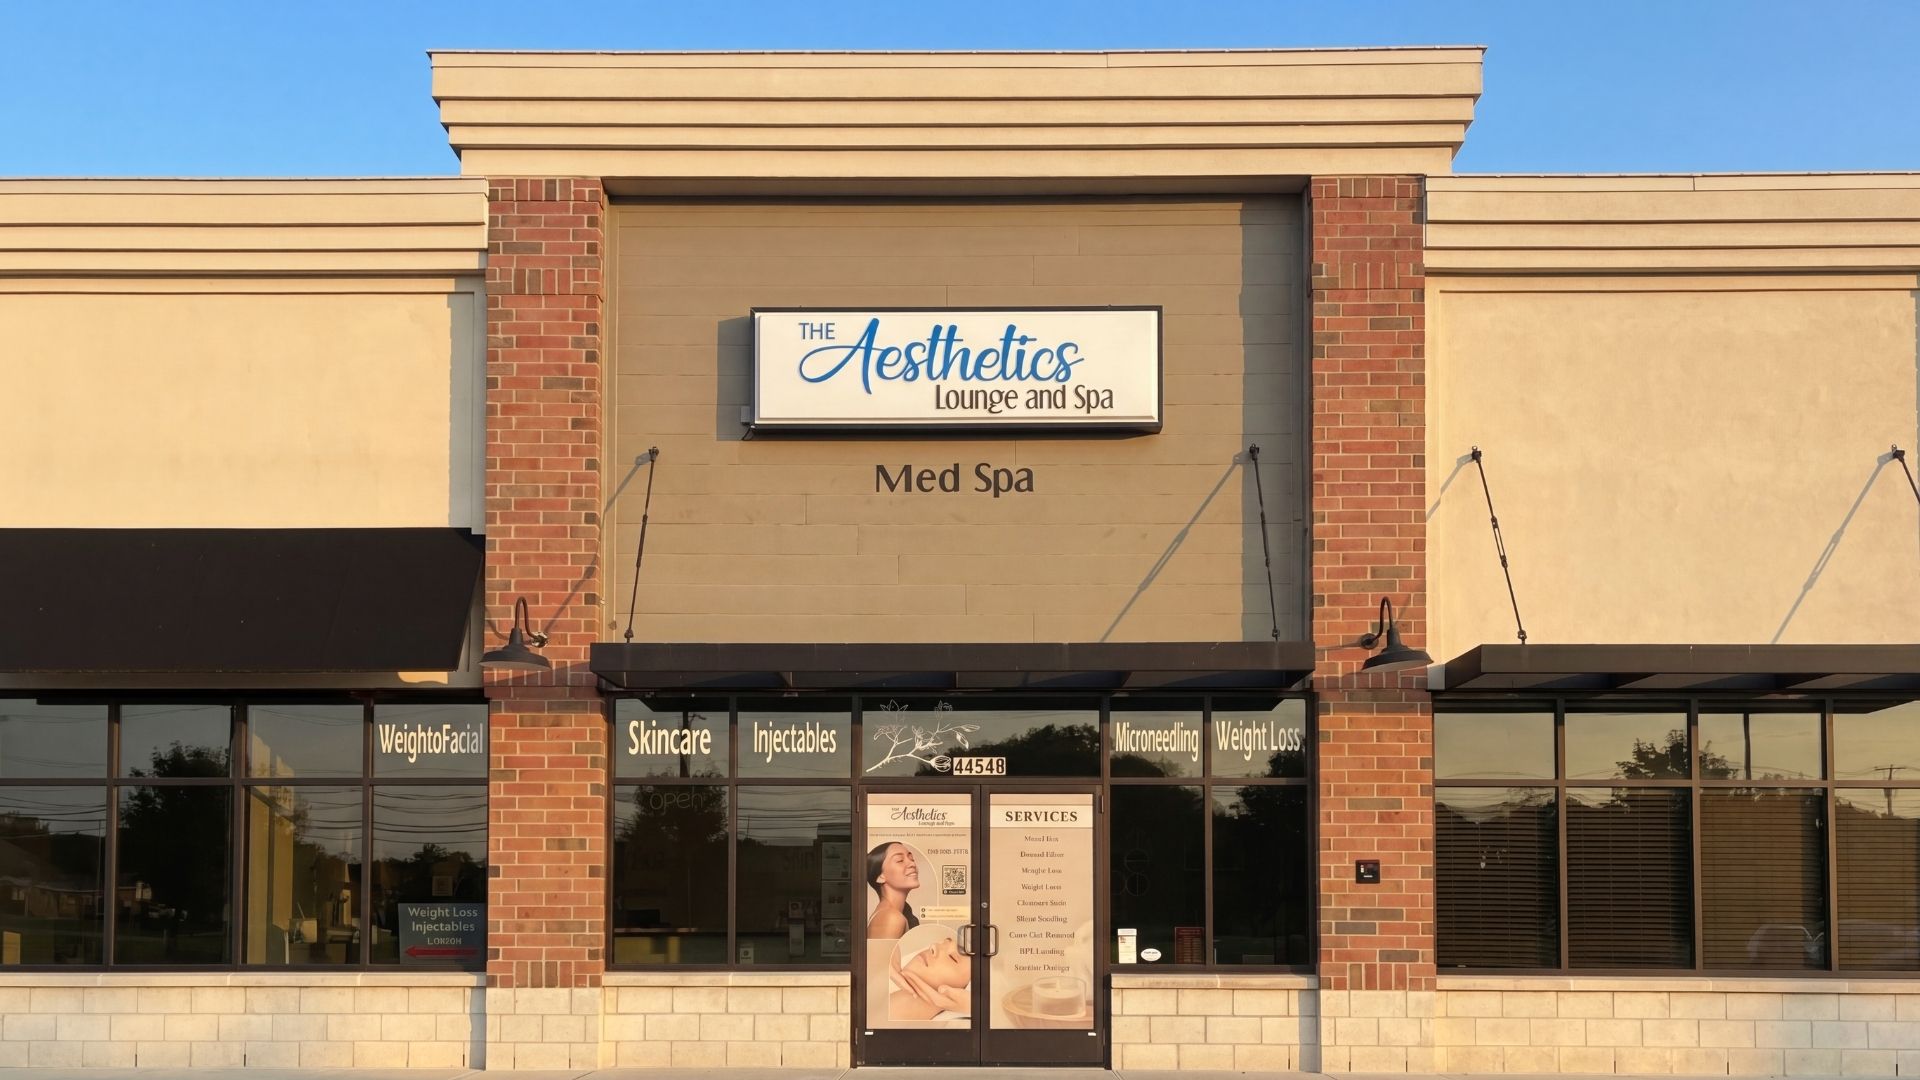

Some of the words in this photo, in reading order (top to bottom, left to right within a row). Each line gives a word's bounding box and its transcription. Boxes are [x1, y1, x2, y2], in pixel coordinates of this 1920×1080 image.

[799, 322, 836, 340] THE
[799, 317, 1085, 395] Aesthetics
[935, 385, 1018, 414] Lounge
[1025, 385, 1067, 410] and
[1073, 384, 1114, 414] Spa
[875, 463, 960, 493] Med
[974, 463, 1035, 498] Spa
[379, 723, 483, 764] WeightoFacial
[628, 720, 712, 755] Skincare
[754, 721, 837, 763] Injectables
[1115, 722, 1199, 762] Microneedling
[1215, 720, 1267, 761] Weight
[1270, 720, 1301, 751] Loss
[954, 758, 1005, 774] 44548
[1005, 811, 1078, 822] SERVICES
[407, 907, 450, 920] Weight
[452, 907, 478, 917] Loss
[412, 921, 475, 935] Injectables
